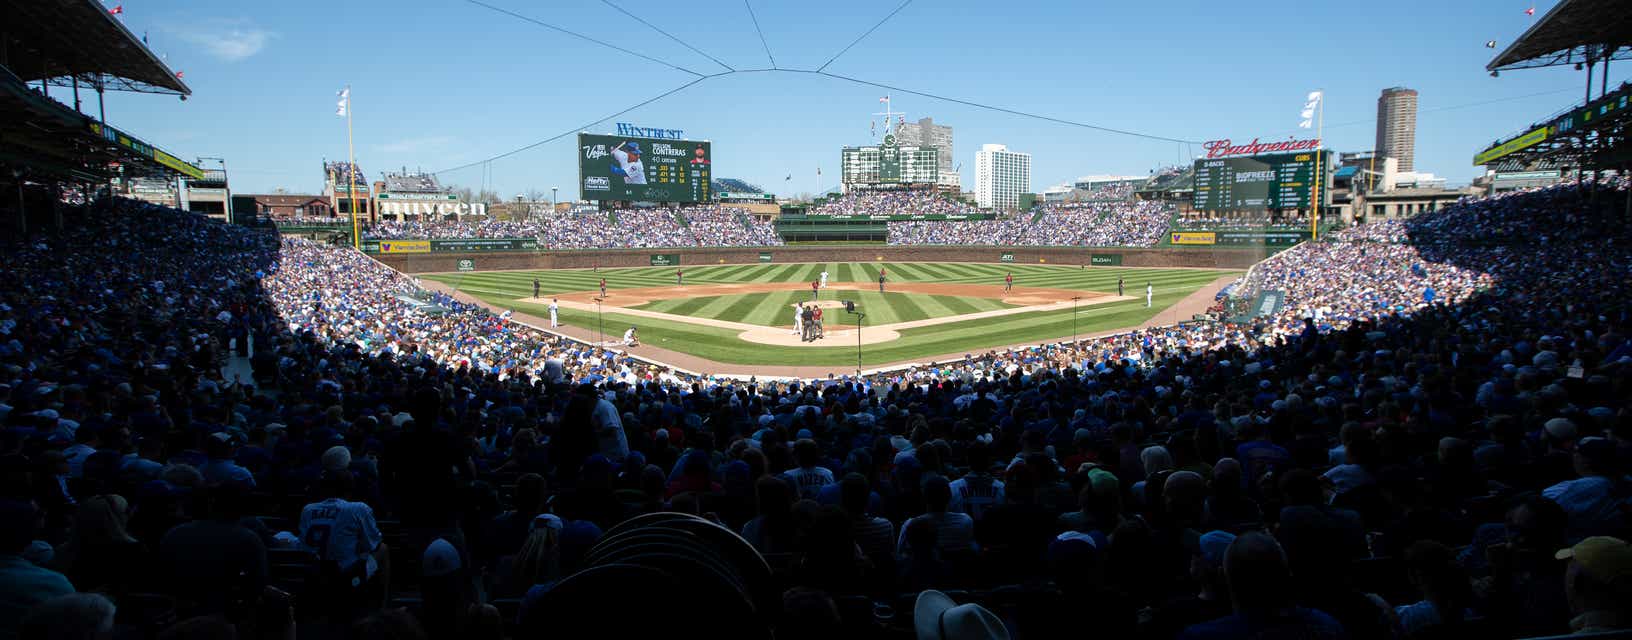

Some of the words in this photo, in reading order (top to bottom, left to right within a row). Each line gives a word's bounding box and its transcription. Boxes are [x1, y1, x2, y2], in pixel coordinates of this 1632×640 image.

[616, 123, 683, 140] WINTRUST
[652, 148, 686, 156] CONTRERAS
[1203, 137, 1320, 158] Budweiser
[1295, 154, 1311, 162] CUBS
[1235, 170, 1277, 179] BIOFREEZE
[382, 201, 486, 216] nuveen
